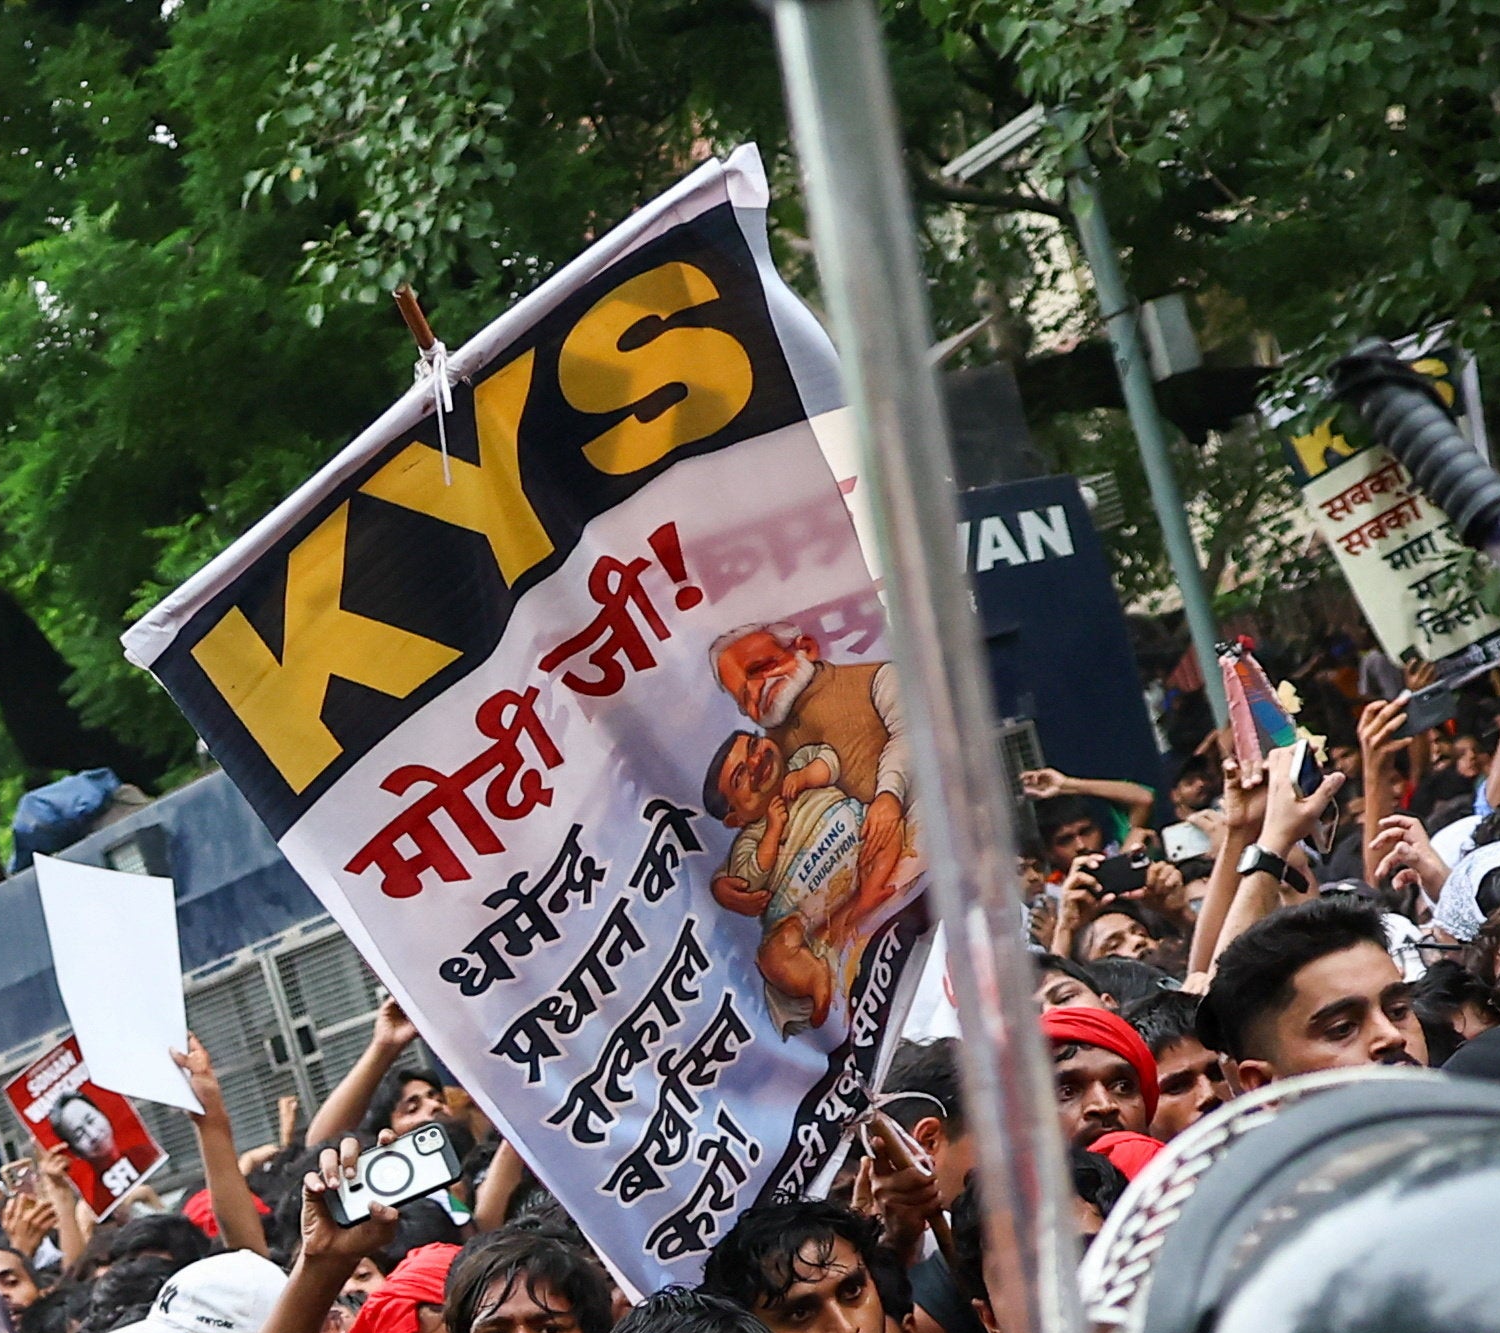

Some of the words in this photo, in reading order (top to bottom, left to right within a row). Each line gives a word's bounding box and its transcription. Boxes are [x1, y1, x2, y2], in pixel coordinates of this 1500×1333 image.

[191, 260, 754, 796] KYS
[1337, 491, 1423, 556] सबको
[345, 684, 567, 900] मोदी
[538, 521, 705, 701] जी!
[798, 820, 846, 883] LEAKING
[808, 832, 857, 893] EDUCATION
[490, 896, 647, 1083] प्रधान
[629, 799, 703, 903] को
[851, 922, 902, 1047] संगठन
[547, 918, 712, 1144] तत्काल
[602, 993, 751, 1202] बर्खास्त
[102, 1157, 139, 1197] SFI
[645, 1104, 762, 1262] करो!
